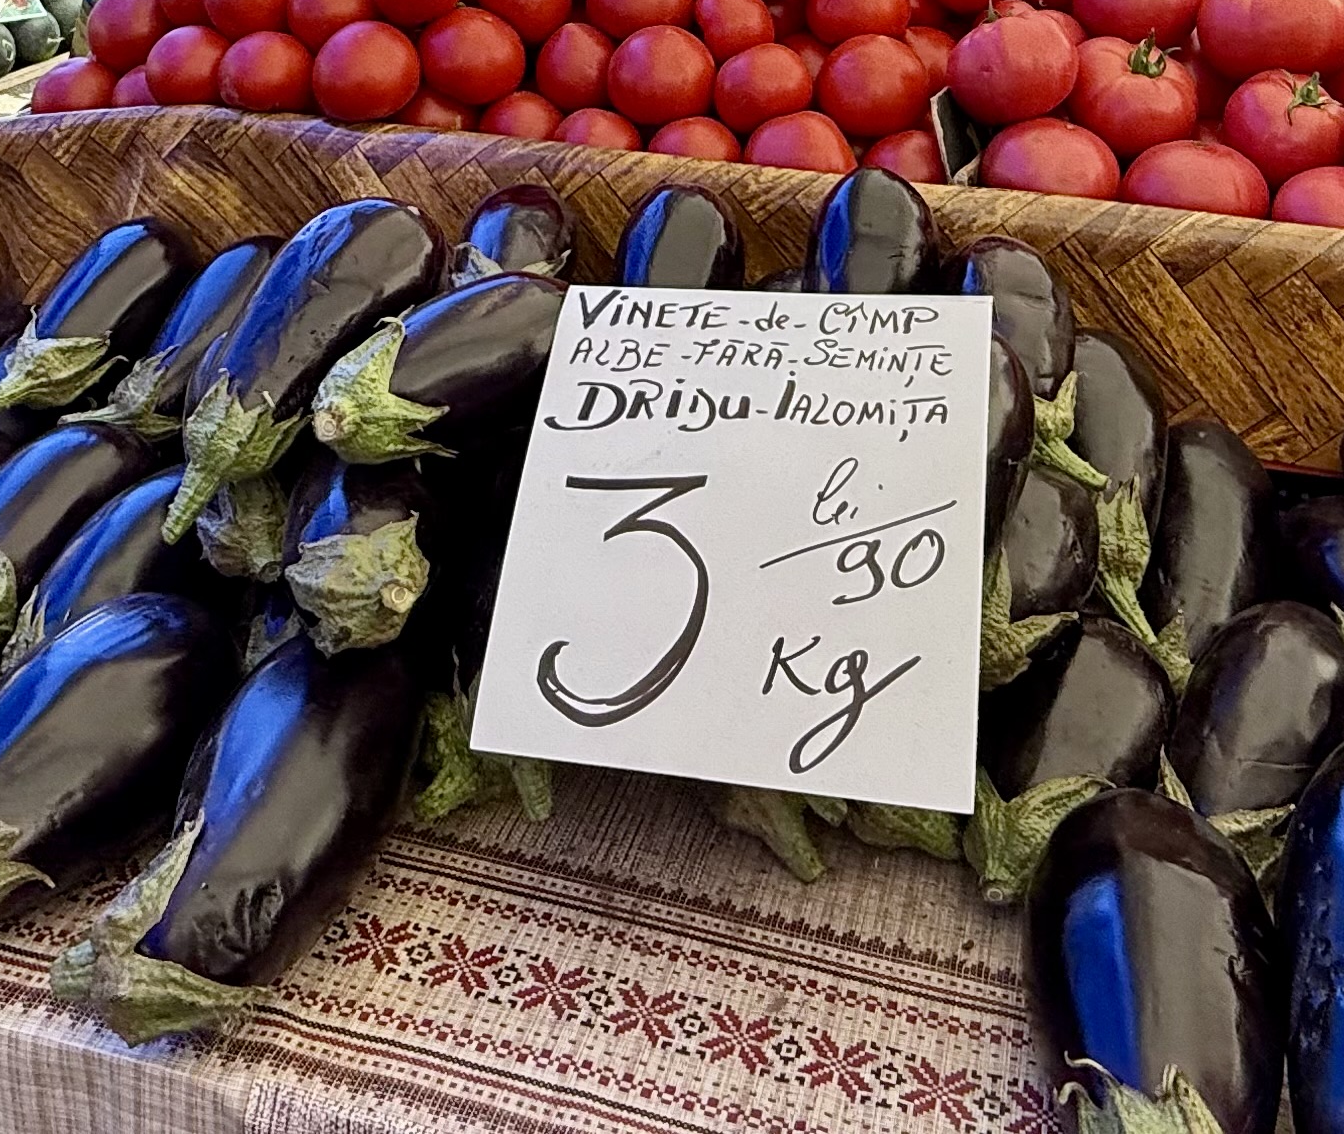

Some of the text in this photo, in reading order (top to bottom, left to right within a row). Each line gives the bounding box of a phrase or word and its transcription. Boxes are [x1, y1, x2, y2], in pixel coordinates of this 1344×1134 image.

[537, 475, 946, 728] 3 90
[762, 635, 923, 775] Kg
